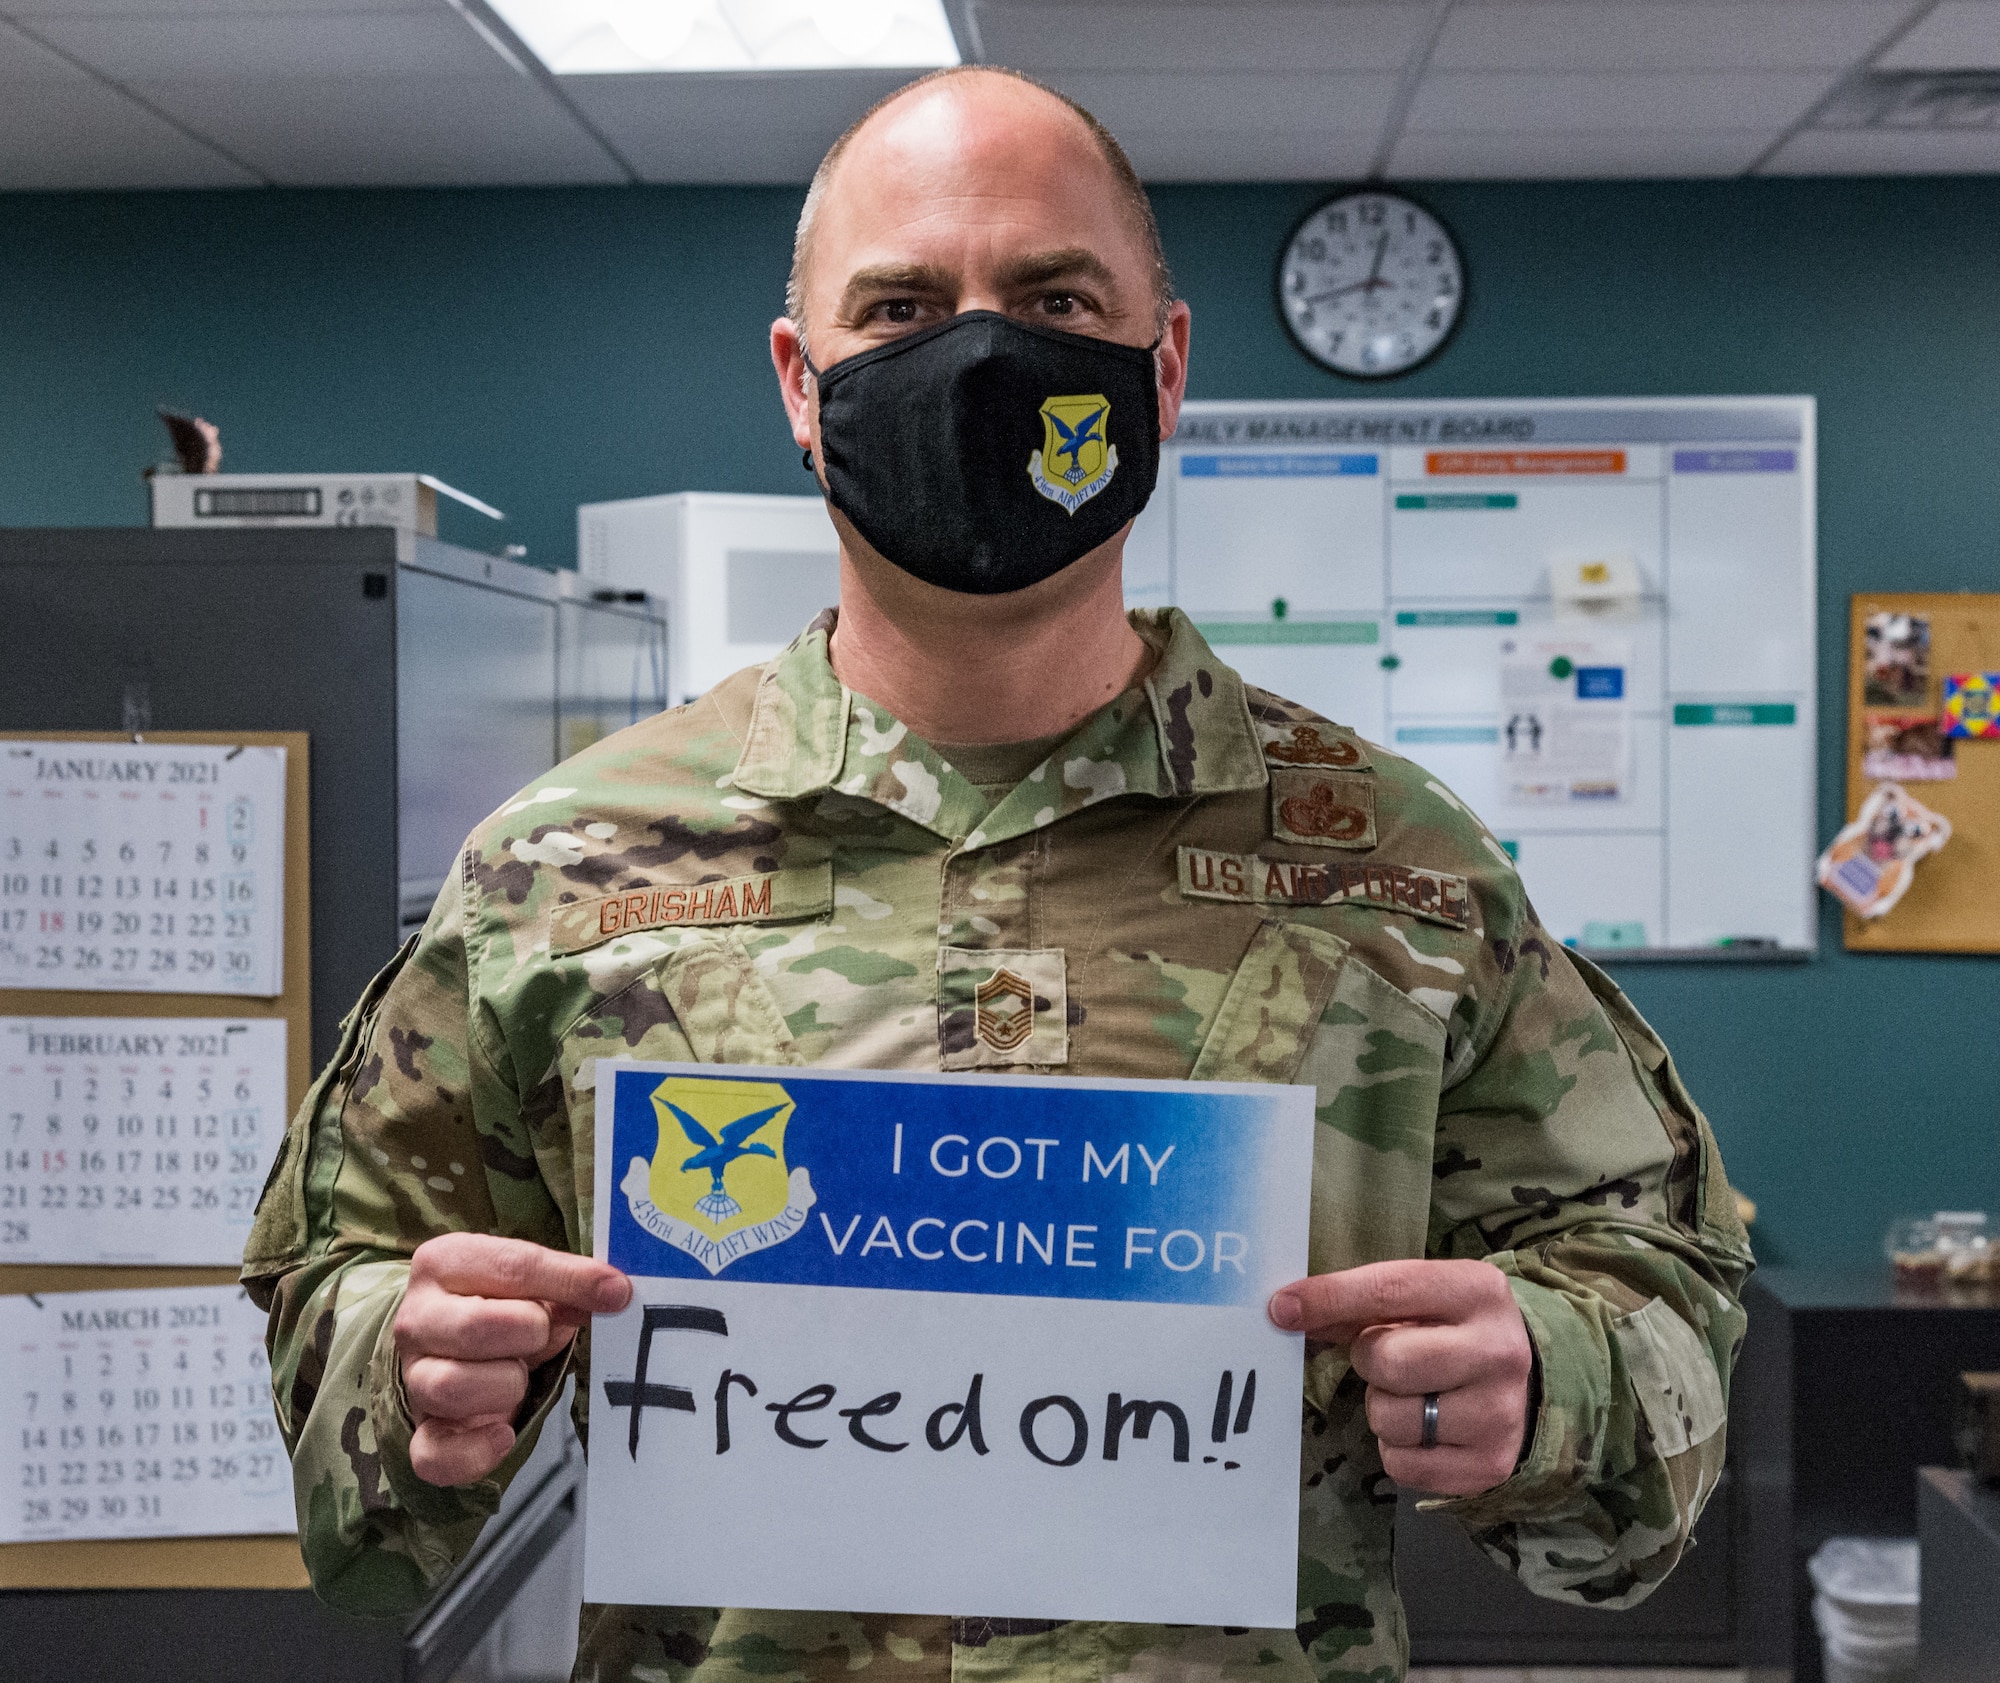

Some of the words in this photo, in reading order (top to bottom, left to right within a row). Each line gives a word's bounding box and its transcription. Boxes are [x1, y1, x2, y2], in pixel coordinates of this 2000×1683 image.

[1327, 211, 1347, 233] 11
[1358, 201, 1387, 226] 12
[1405, 211, 1416, 235] 1
[1299, 236, 1327, 262] 10
[1426, 239, 1444, 266] 2
[1437, 272, 1454, 295] 3
[1425, 309, 1441, 331] 4
[1329, 329, 1346, 353] 7
[1246, 418, 1431, 439] MANAGEMENT
[1437, 415, 1535, 439] BOARD
[1058, 485, 1089, 509] AIRLIFT
[36, 759, 157, 783] JANUARY
[168, 761, 220, 784] 2021
[200, 807, 207, 827] 1
[234, 807, 247, 830] 2
[10, 837, 22, 862] 3
[45, 839, 59, 861] 4
[83, 839, 97, 863] 5
[119, 841, 135, 863] 6
[158, 841, 172, 863] 7
[196, 843, 209, 864] 8
[232, 843, 247, 863] 9
[3, 874, 29, 897] 10
[41, 875, 62, 898] 11
[77, 875, 103, 898] 12
[116, 877, 141, 898] 13
[153, 878, 178, 898] 14
[191, 879, 215, 900] 15
[228, 880, 252, 901] 16
[1264, 860, 1325, 901] AIR
[1340, 865, 1457, 919] FORCE
[599, 878, 772, 935] GRISHAM
[3, 909, 27, 932] 17
[40, 911, 64, 933] 18
[77, 911, 103, 933] 19
[112, 913, 141, 935] 20
[150, 913, 176, 936] 21
[188, 914, 215, 937] 22
[225, 914, 251, 937] 23
[37, 945, 64, 970] 25
[74, 946, 103, 970] 26
[112, 946, 140, 971] 27
[150, 947, 178, 971] 28
[188, 948, 215, 972] 29
[225, 950, 251, 972] 30
[28, 1032, 169, 1056] FEBRUARY
[177, 1034, 230, 1056] 2021
[52, 1078, 62, 1101] 1
[84, 1078, 98, 1102] 2
[122, 1079, 135, 1101] 3
[158, 1079, 173, 1100] 4
[198, 1079, 212, 1101] 5
[234, 1079, 250, 1102] 6
[10, 1112, 25, 1137] 7
[46, 1114, 62, 1136] 8
[83, 1114, 99, 1137] 9
[117, 1115, 143, 1137] 10
[156, 1116, 177, 1137] 11
[194, 1116, 218, 1138] 12
[231, 1116, 256, 1138] 13
[5, 1149, 30, 1173] 14
[42, 1149, 67, 1173] 15
[79, 1150, 106, 1174] 16
[117, 1150, 142, 1173] 17
[155, 1151, 180, 1174] 18
[194, 1152, 219, 1174] 19
[229, 1150, 257, 1173] 20
[893, 1123, 902, 1174] I
[930, 1135, 1059, 1180] GOT
[1082, 1141, 1175, 1186] MY
[2, 1184, 28, 1209] 21
[40, 1184, 68, 1209] 22
[77, 1185, 104, 1209] 23
[114, 1186, 142, 1210] 24
[152, 1186, 180, 1210] 25
[191, 1187, 219, 1210] 26
[228, 1186, 255, 1210] 27
[2, 1220, 30, 1245] 28
[633, 1200, 674, 1240] 436TH
[680, 1229, 750, 1268] AIRLIFT
[751, 1205, 804, 1246] WING
[819, 1212, 1098, 1268] VACCINE
[1124, 1227, 1249, 1274] FOR
[61, 1308, 159, 1332] MARCH
[168, 1305, 220, 1328] 2021
[63, 1355, 73, 1378] 1
[99, 1354, 113, 1377] 2
[138, 1352, 150, 1373] 3
[174, 1351, 188, 1372] 4
[213, 1350, 226, 1371] 5
[249, 1348, 265, 1368] 6
[24, 1391, 38, 1413] 7
[62, 1391, 77, 1413] 8
[99, 1390, 115, 1411] 9
[133, 1388, 160, 1410] 10
[172, 1387, 194, 1408] 11
[209, 1385, 235, 1407] 12
[604, 1304, 1256, 1471] Freedom!!
[22, 1428, 47, 1450] 14
[59, 1426, 85, 1449] 15
[97, 1425, 123, 1448] 16
[135, 1423, 160, 1446] 17
[173, 1422, 198, 1444] 18
[211, 1420, 237, 1443] 19
[246, 1419, 274, 1442] 20
[22, 1464, 47, 1487] 21
[60, 1462, 86, 1486] 22
[97, 1460, 124, 1484] 23
[135, 1459, 162, 1482] 24
[172, 1458, 199, 1481] 25
[210, 1457, 238, 1479] 26
[247, 1455, 274, 1478] 27
[23, 1500, 50, 1523] 28
[61, 1498, 89, 1521] 29
[98, 1497, 127, 1520] 30
[135, 1495, 161, 1518] 31
